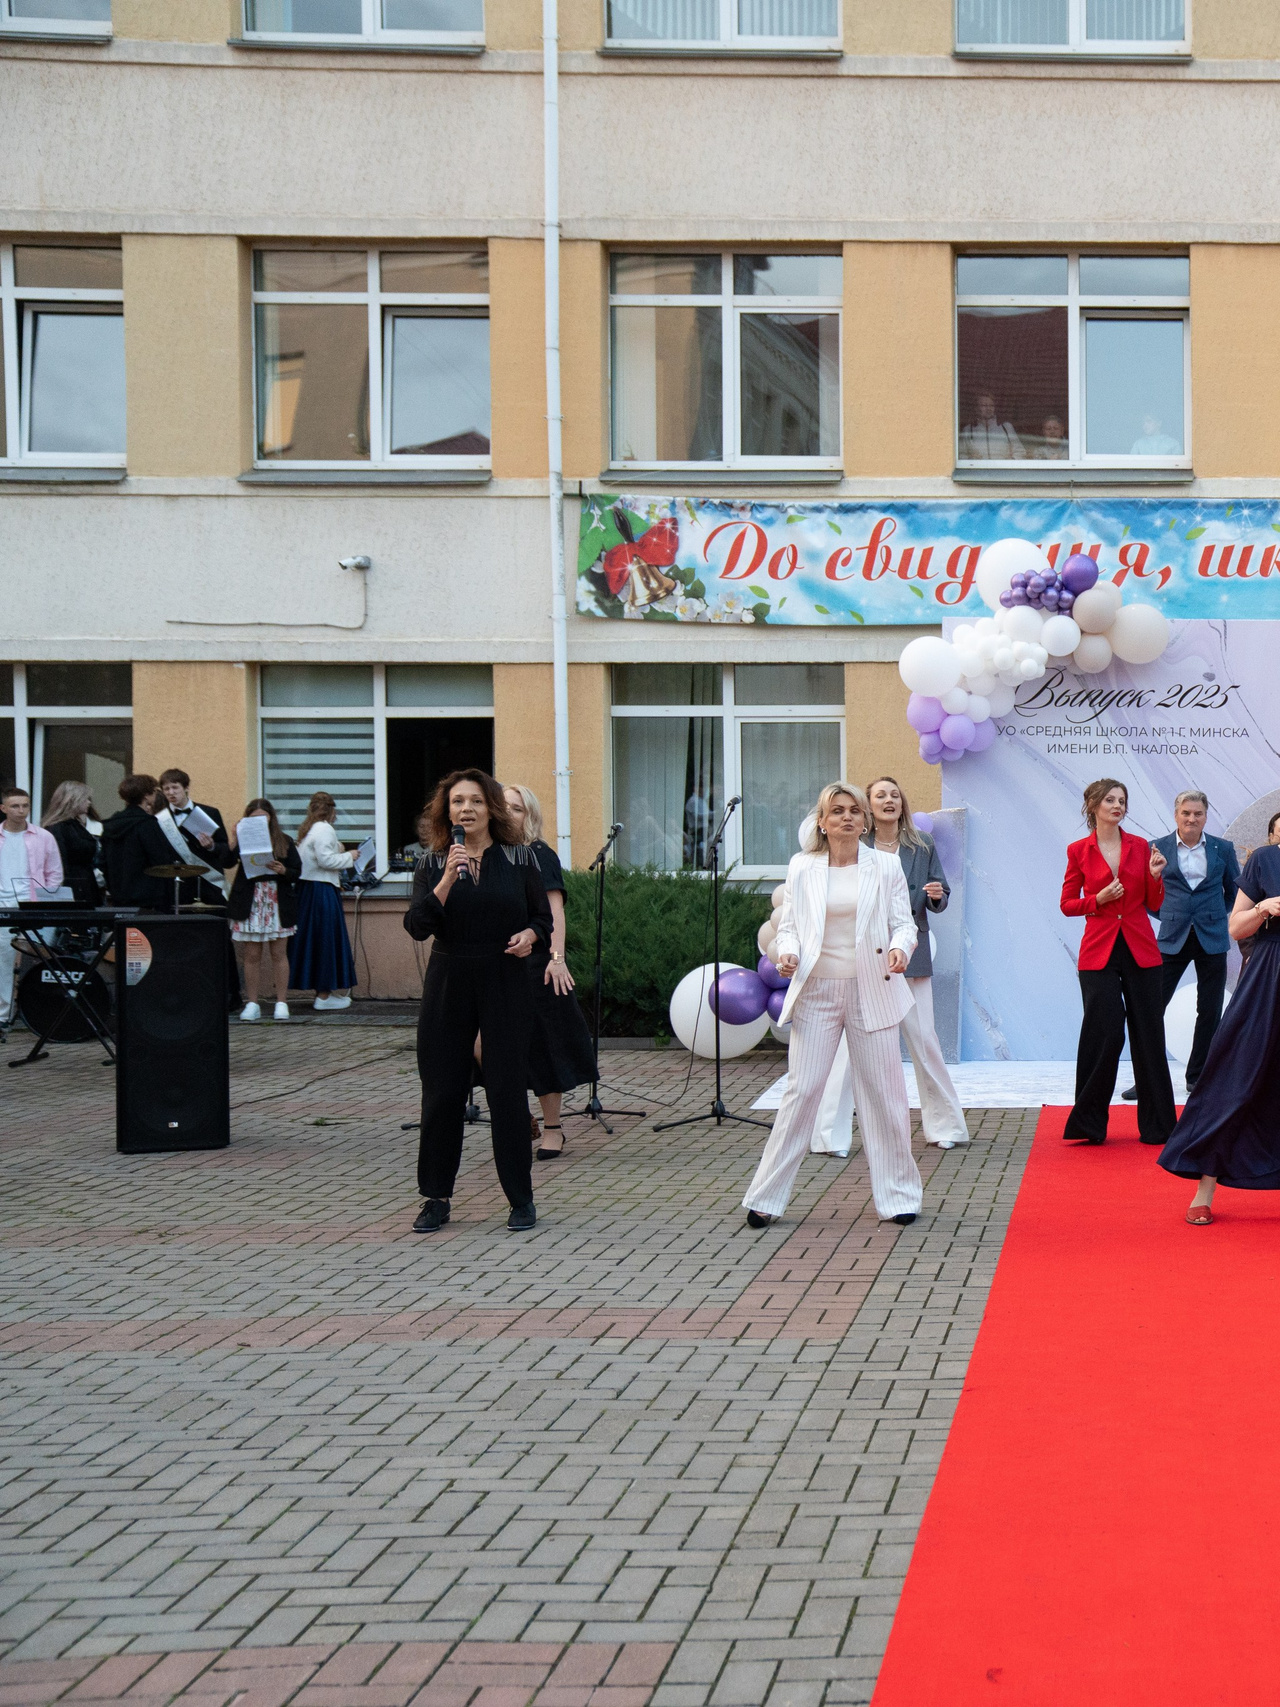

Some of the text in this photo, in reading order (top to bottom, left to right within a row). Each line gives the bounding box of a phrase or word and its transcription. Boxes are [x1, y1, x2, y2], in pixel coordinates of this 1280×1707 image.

[703, 520, 804, 581] До
[825, 516, 1173, 606] свидя,
[1014, 666, 1241, 724] Выпуск 2025
[996, 725, 1017, 737] УО
[1020, 725, 1091, 738] «СРЕДНЯЯ
[1096, 726, 1148, 737] ШКОЛА
[1189, 727, 1250, 738] МИНСКА
[1047, 743, 1199, 755] ИМЕНИ В.П. ЧКАЛОВА
